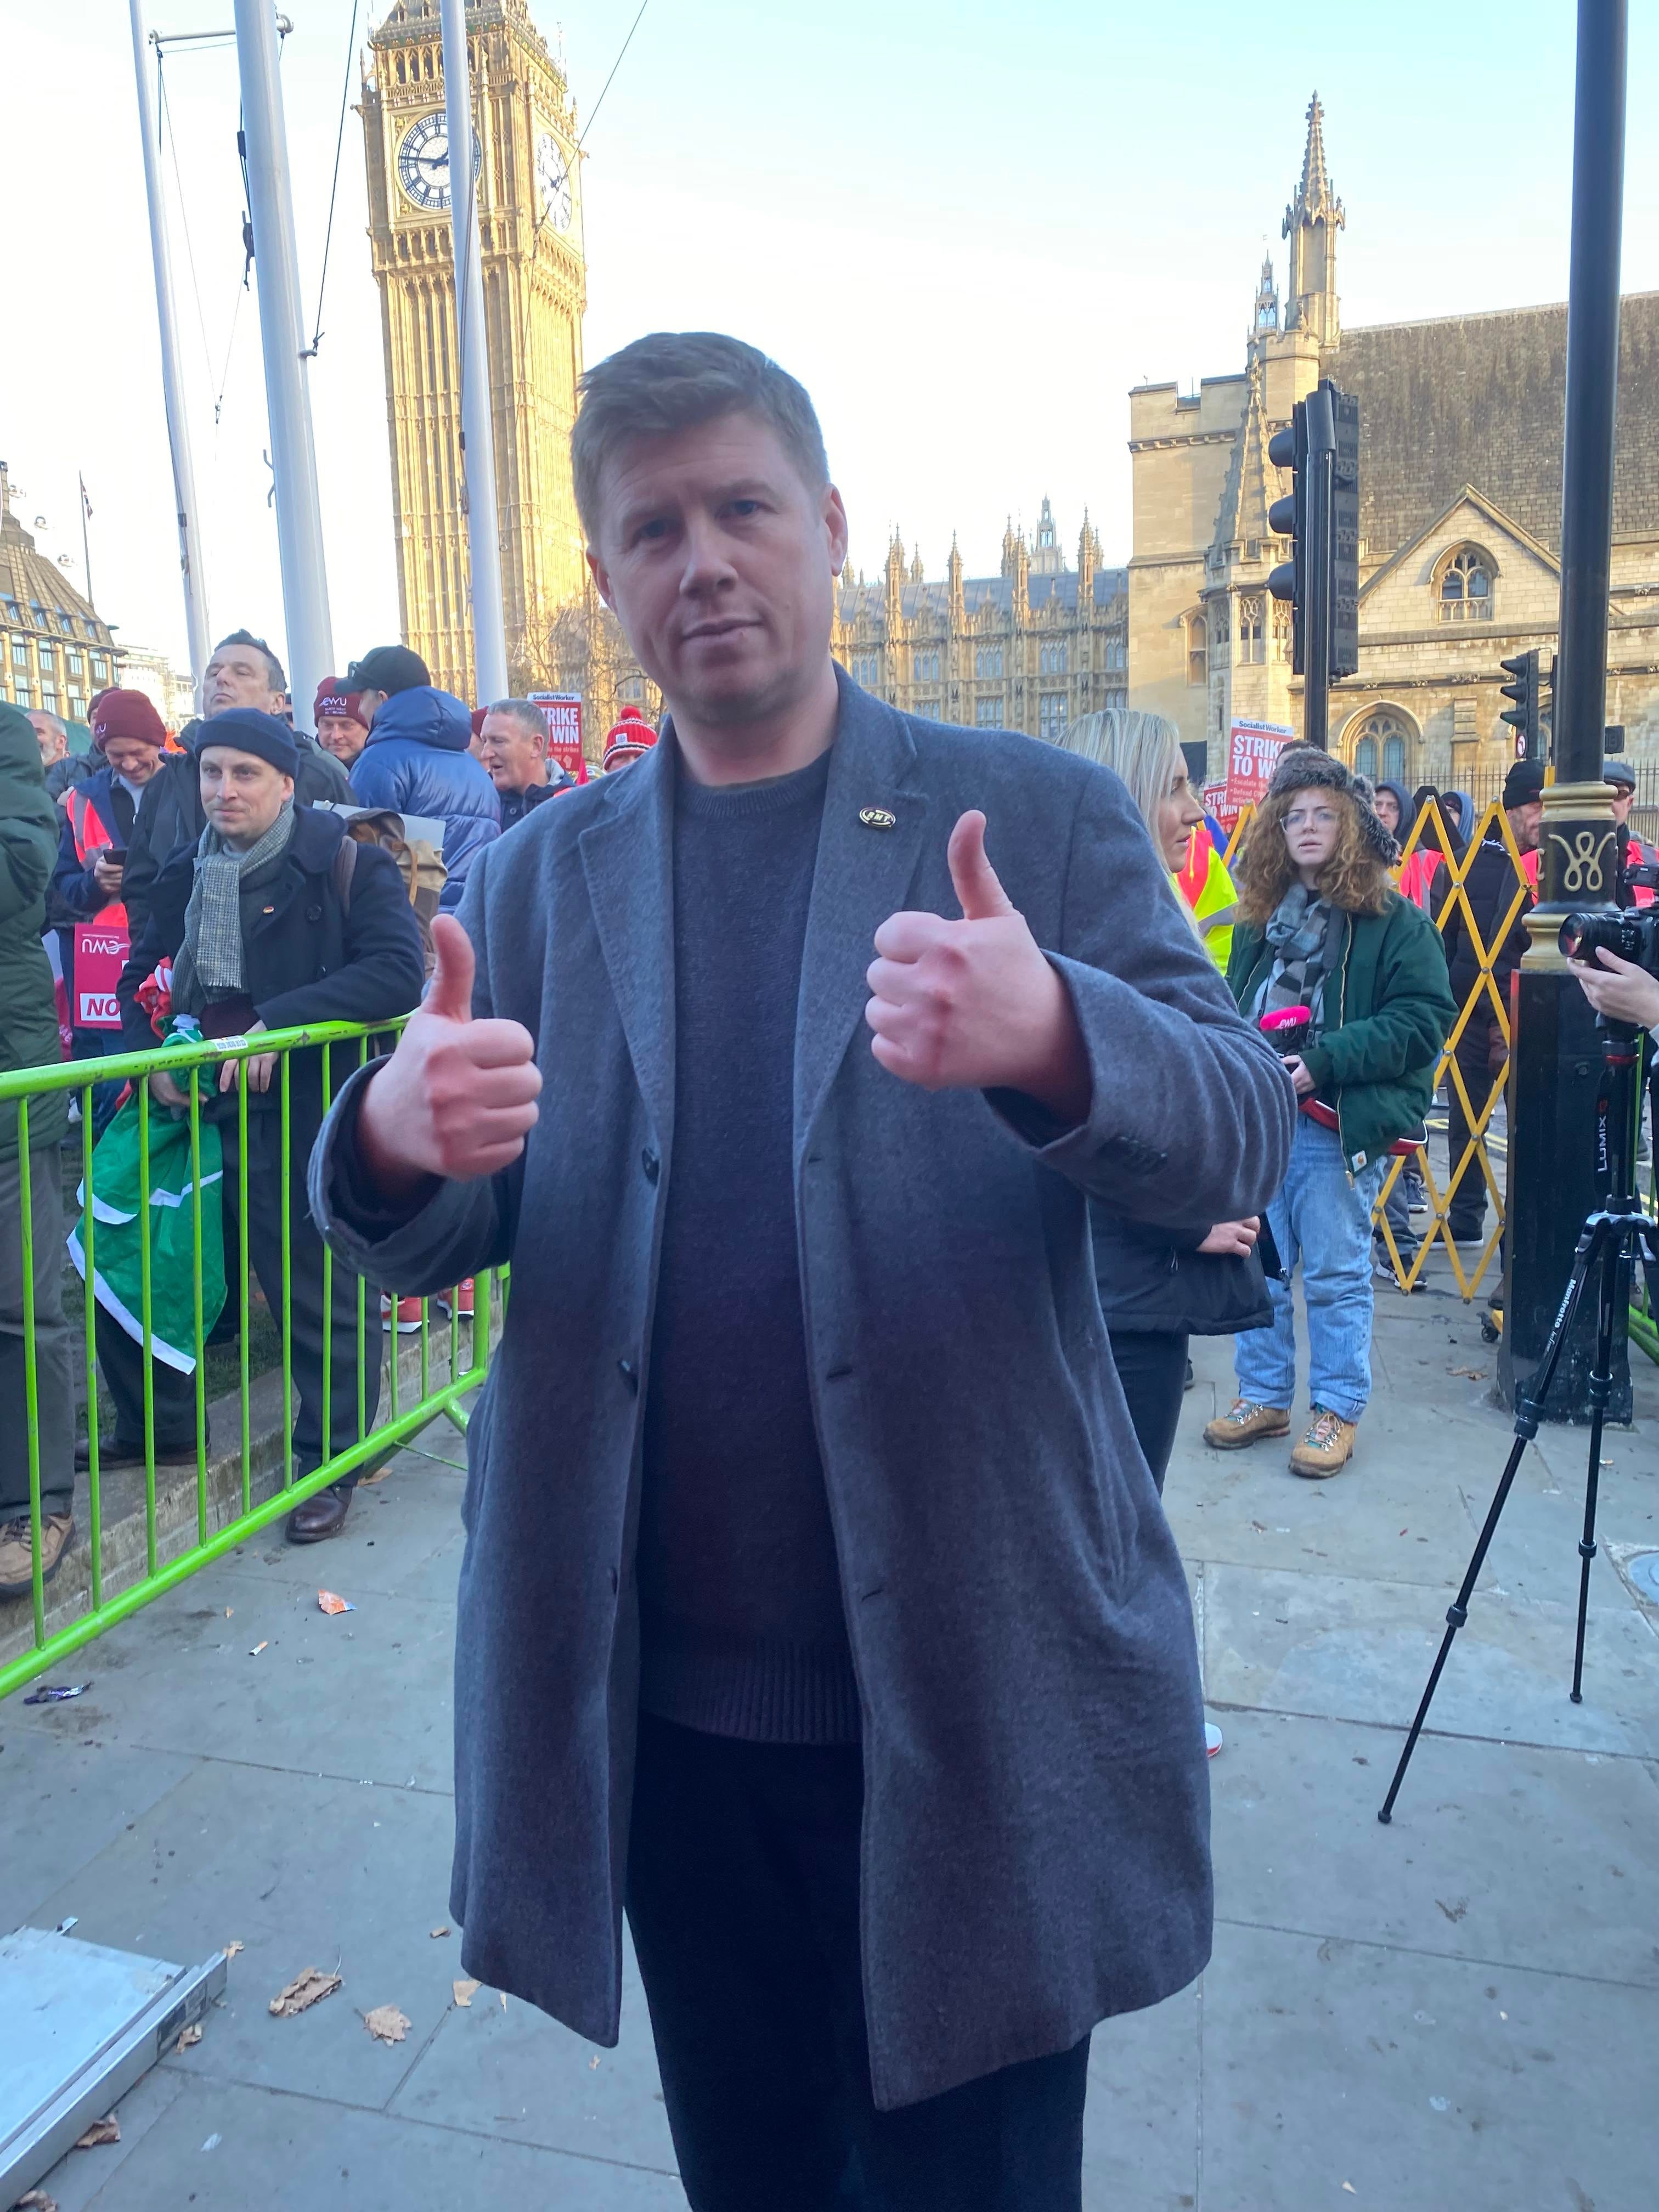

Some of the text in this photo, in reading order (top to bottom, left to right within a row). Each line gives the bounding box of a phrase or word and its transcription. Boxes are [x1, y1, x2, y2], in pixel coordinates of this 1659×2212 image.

[321, 696, 347, 707] CWU
[539, 707, 579, 725] TRIKE
[552, 725, 579, 744] WIN
[1239, 720, 1266, 731] Socialist
[1265, 724, 1287, 734] Worker
[1232, 754, 1253, 777] TO
[867, 811, 890, 822] RMT
[1220, 804, 1238, 817] WIN
[82, 939, 120, 955] CWU
[1598, 1115, 1608, 1172] LUMIX
[1554, 1278, 1577, 1328] Manfrotto
